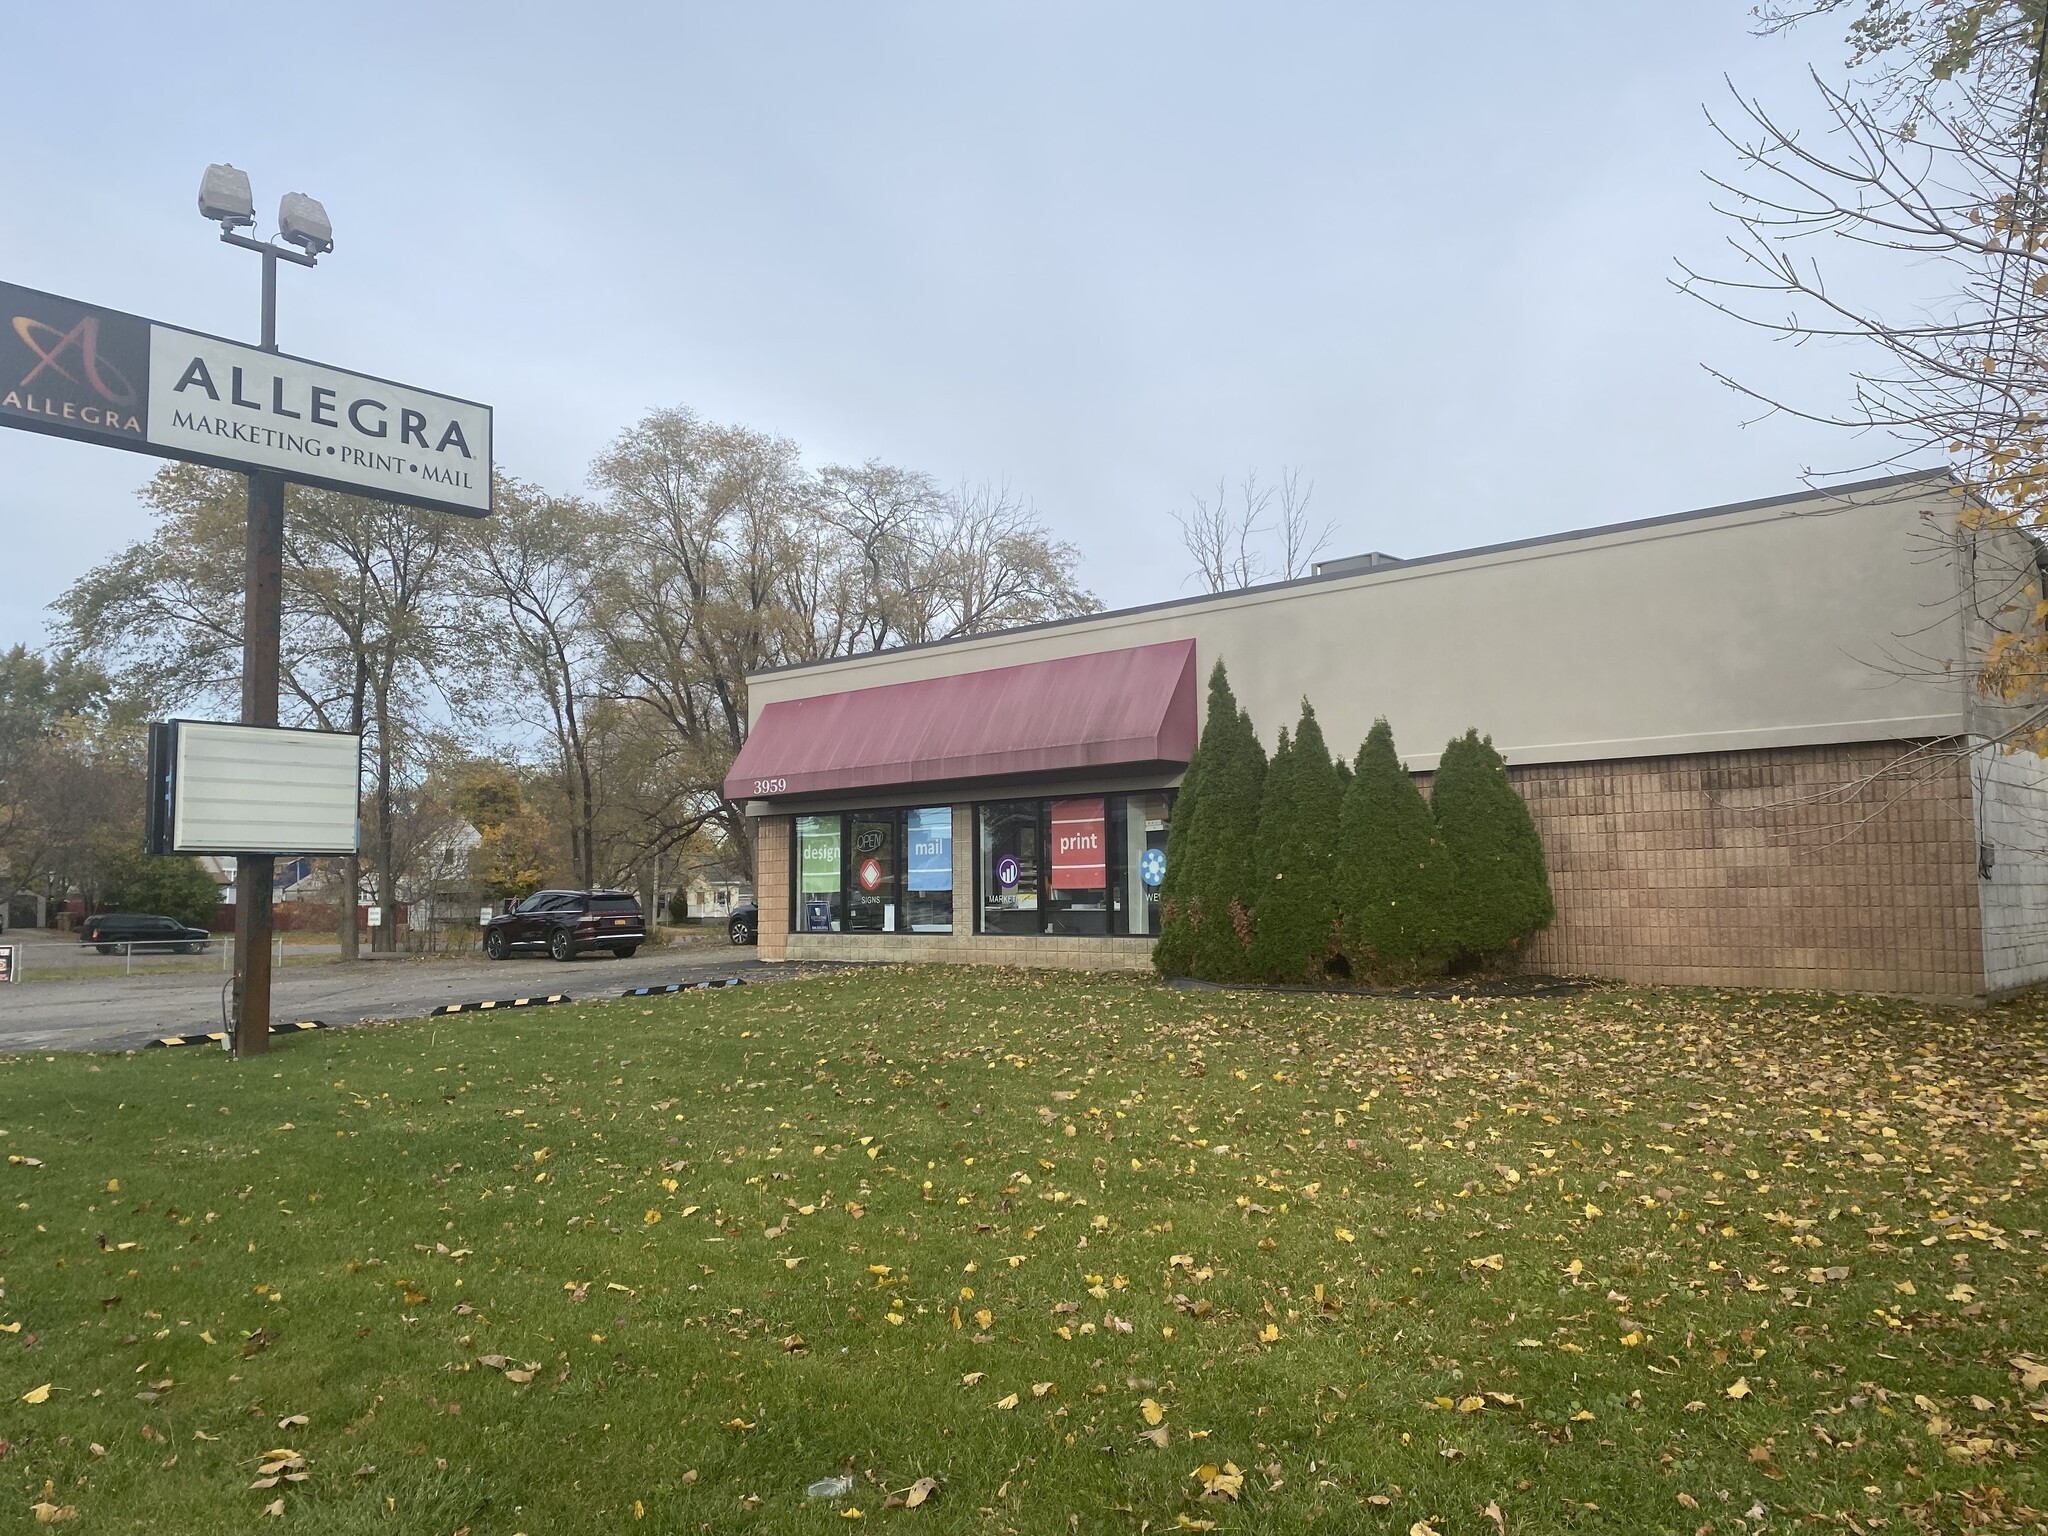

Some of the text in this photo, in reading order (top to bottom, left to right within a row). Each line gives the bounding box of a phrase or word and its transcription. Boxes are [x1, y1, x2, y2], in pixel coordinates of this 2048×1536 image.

[2, 390, 141, 433] ALLEGRA
[173, 356, 473, 459] ALLEGRA
[172, 409, 473, 490] MARKETING PRINT MAIL
[753, 778, 787, 795] 3959
[857, 834, 881, 849] OPEN
[915, 839, 943, 856] mail
[1060, 833, 1097, 854] print
[803, 844, 841, 863] design
[861, 896, 881, 904] SIGNS
